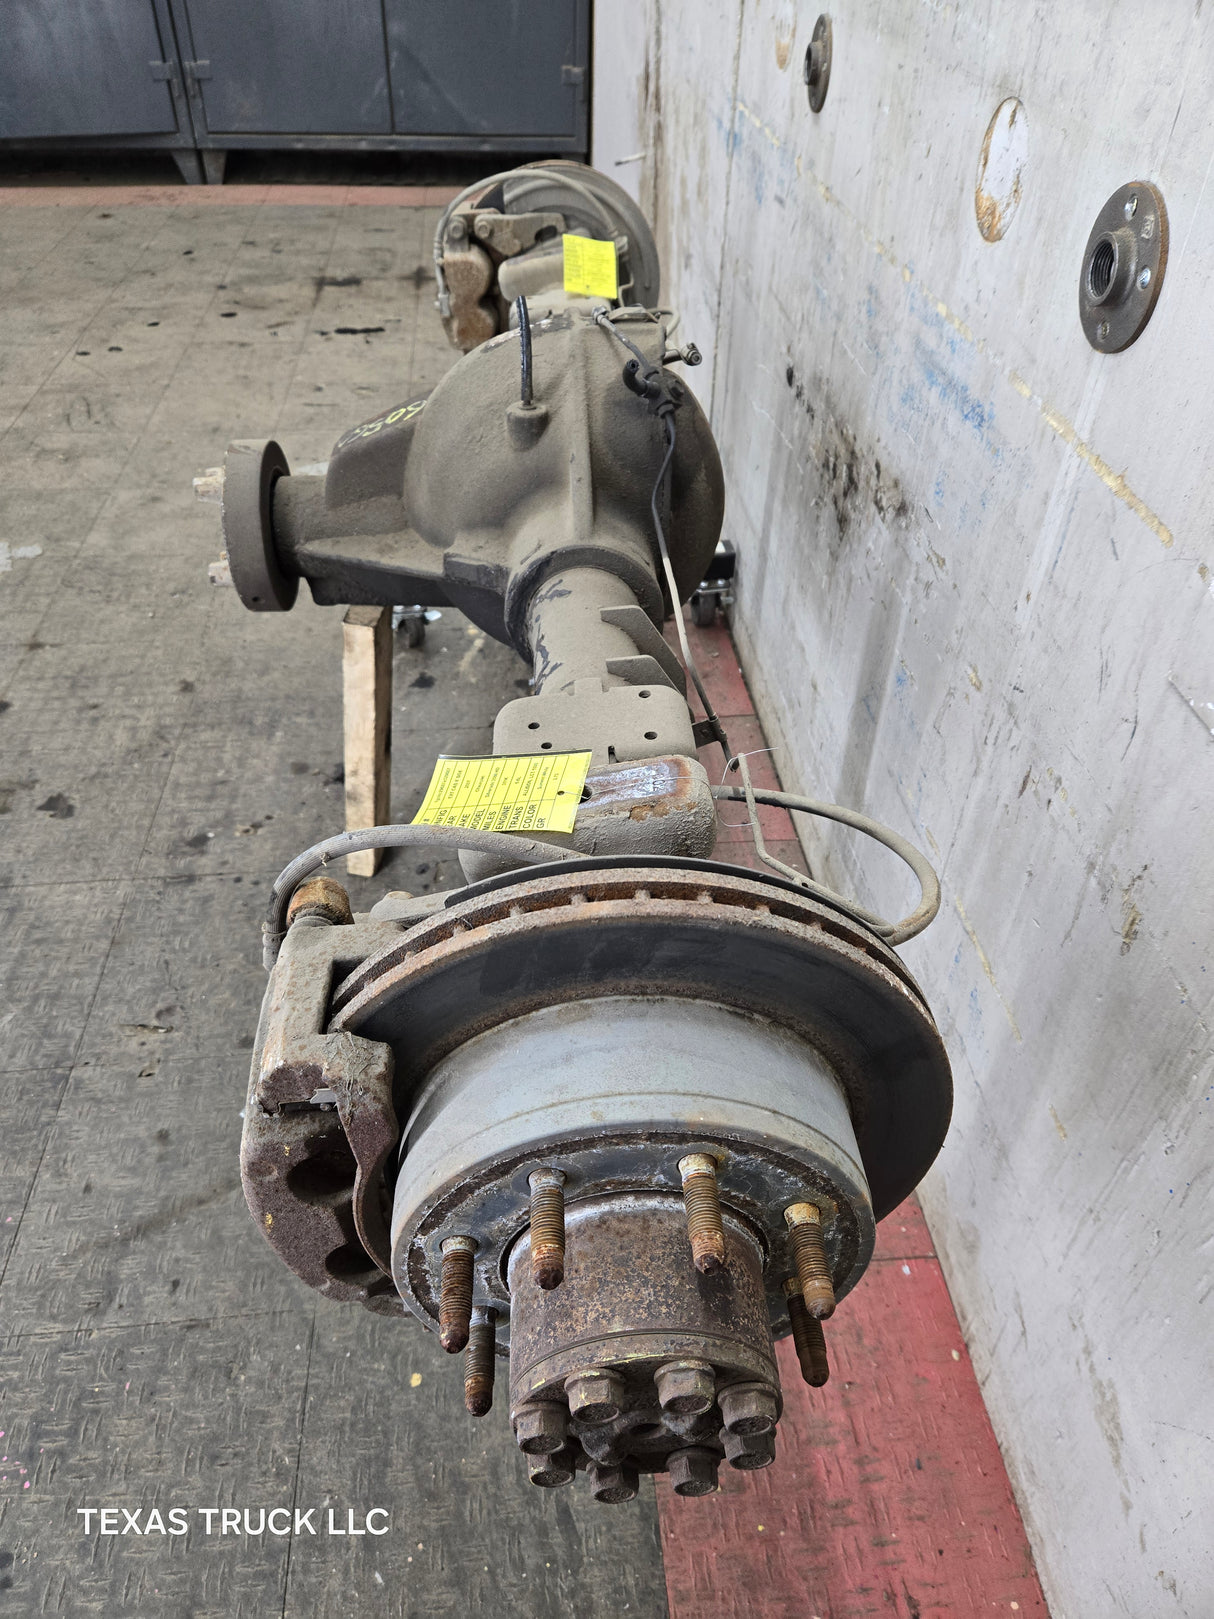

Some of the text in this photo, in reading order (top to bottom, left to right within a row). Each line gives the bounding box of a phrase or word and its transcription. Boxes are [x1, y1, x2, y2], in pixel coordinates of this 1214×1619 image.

[434, 809, 448, 825] NFIG
[459, 813, 471, 828] AKE
[481, 810, 497, 831] MILES
[495, 804, 512, 830] ENGINE
[508, 806, 524, 829] TRANS
[522, 804, 537, 829] COLOR
[536, 817, 546, 829] GR
